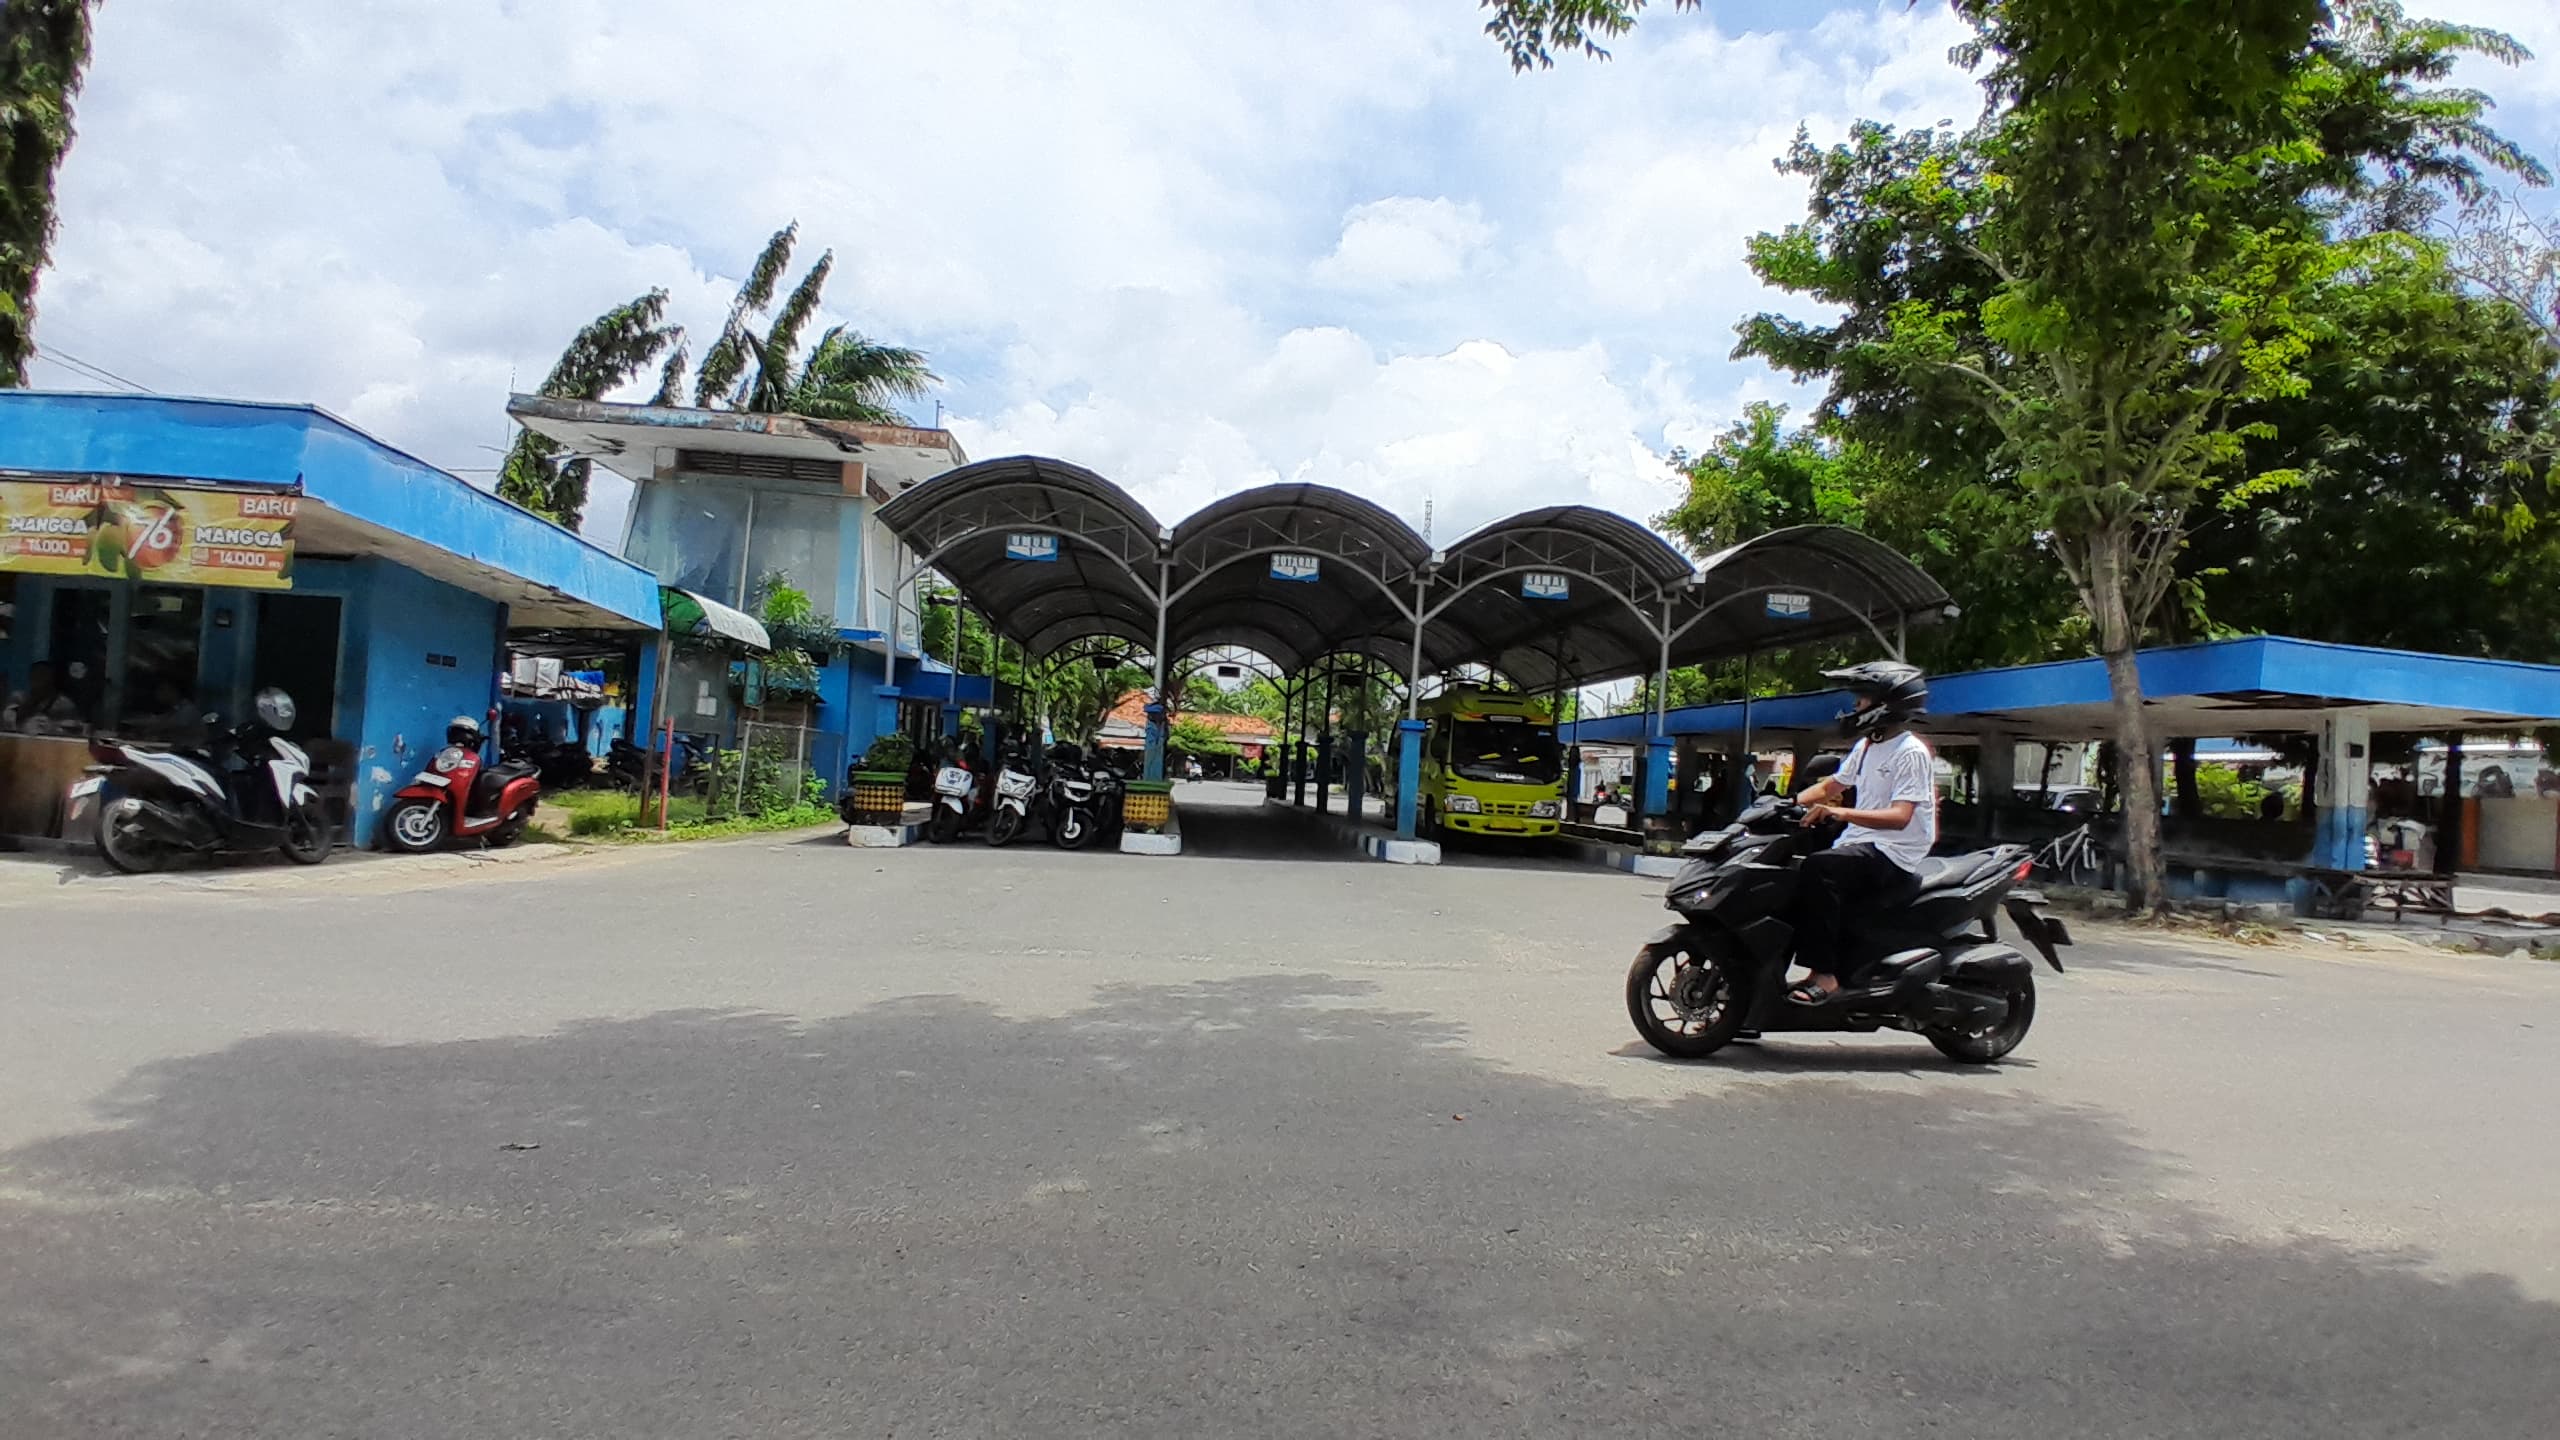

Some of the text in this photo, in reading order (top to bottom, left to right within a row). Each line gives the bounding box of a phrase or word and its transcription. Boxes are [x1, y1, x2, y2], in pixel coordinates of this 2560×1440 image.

[52, 486, 100, 504] BARU
[243, 498, 297, 516] BARU
[10, 517, 88, 534] MANGGA
[195, 527, 283, 547] MANGGA
